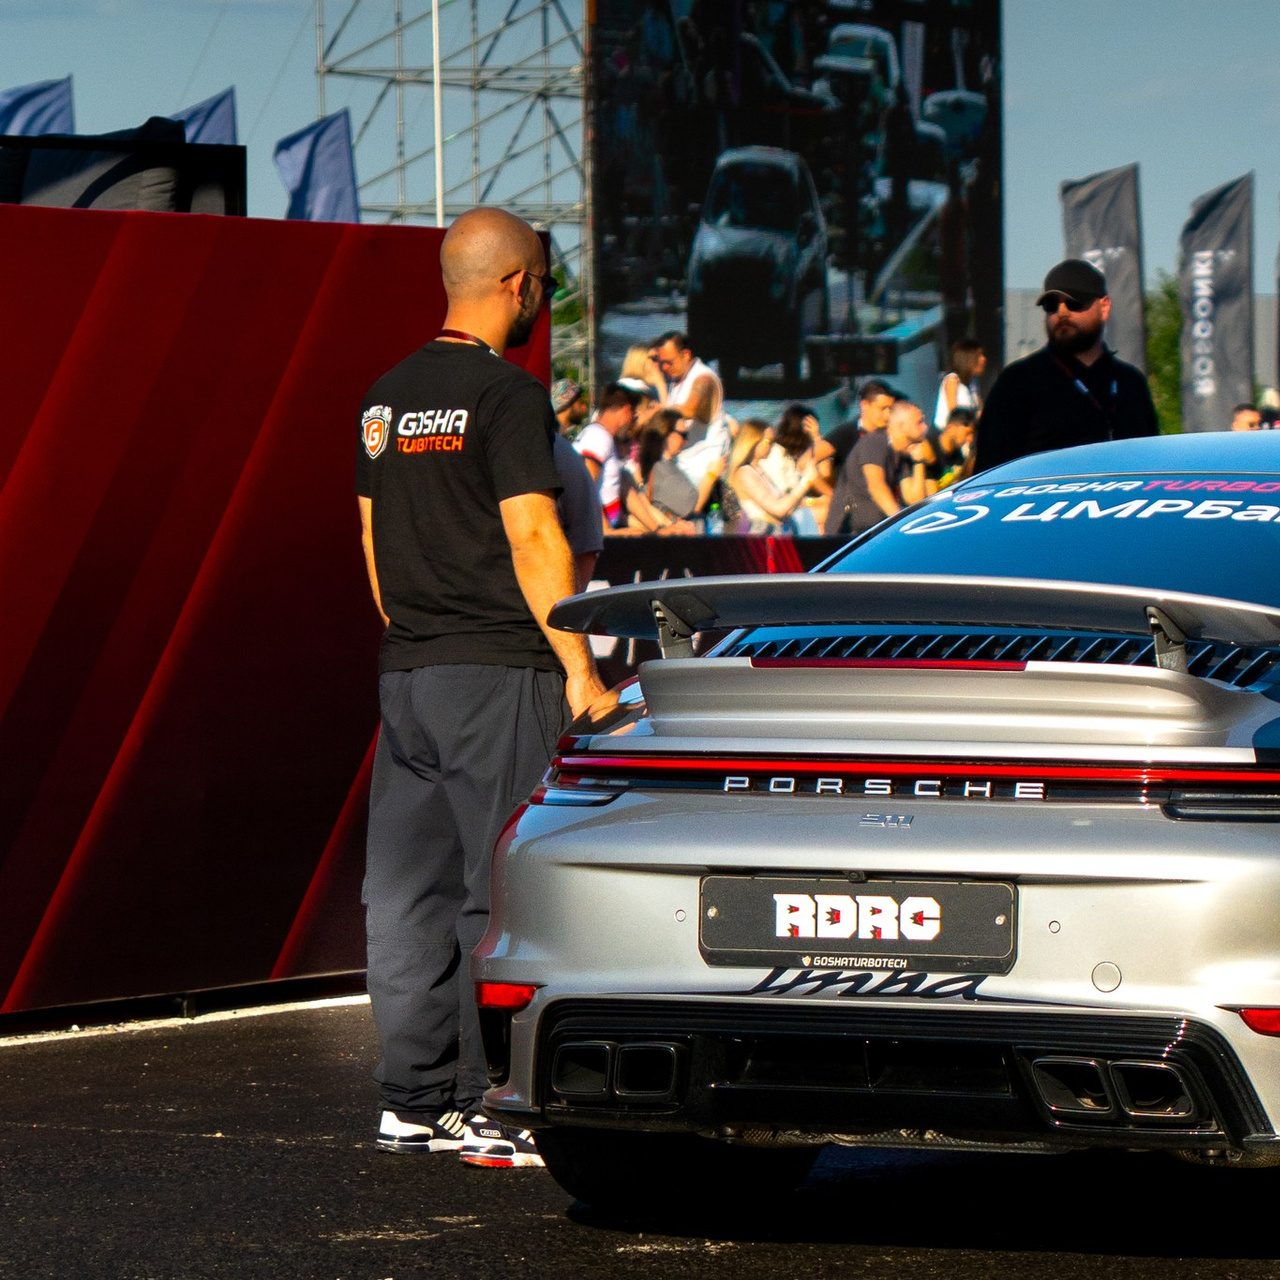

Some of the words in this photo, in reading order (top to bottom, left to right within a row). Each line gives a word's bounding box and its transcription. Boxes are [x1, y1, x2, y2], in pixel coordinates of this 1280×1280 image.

[723, 776, 1045, 799] PORSCHE
[859, 813, 914, 828] 911
[773, 893, 942, 941] RDRC
[813, 956, 907, 969] GOSHATURBOTECH
